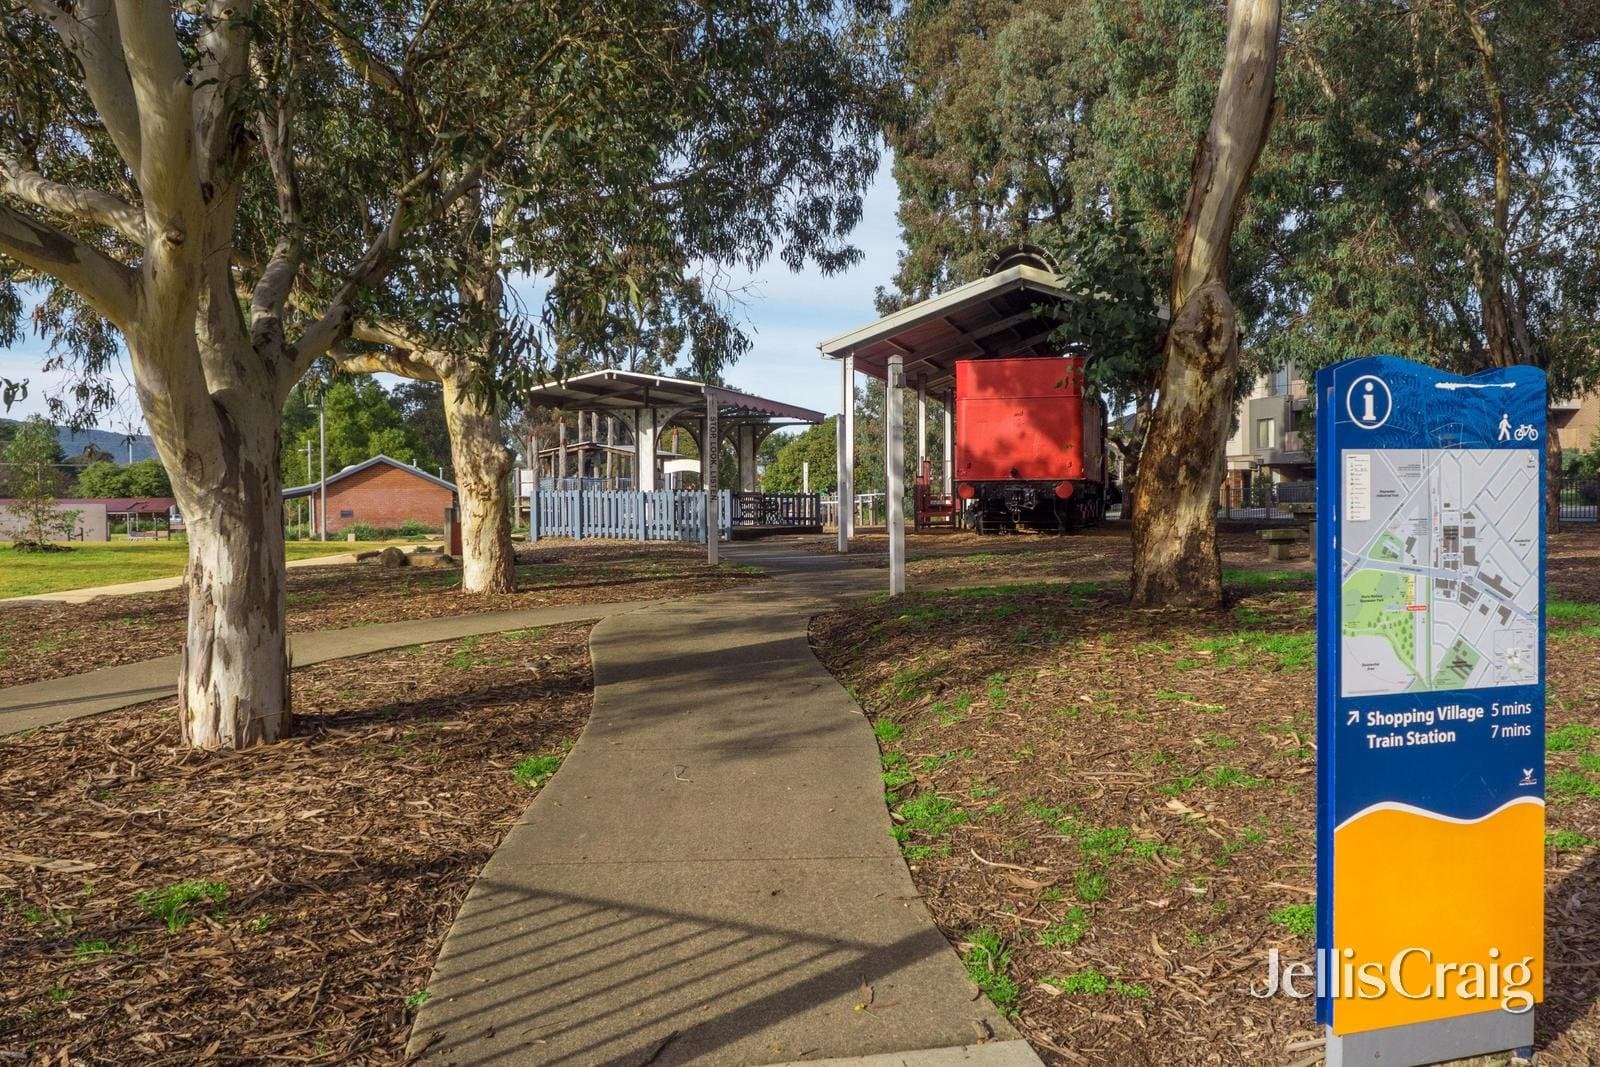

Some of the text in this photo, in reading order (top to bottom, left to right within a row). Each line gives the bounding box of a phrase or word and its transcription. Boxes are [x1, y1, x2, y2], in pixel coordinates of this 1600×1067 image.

[1367, 701, 1532, 728] Shopping Village 5 mins
[1367, 723, 1532, 749] Train Station 7 mins
